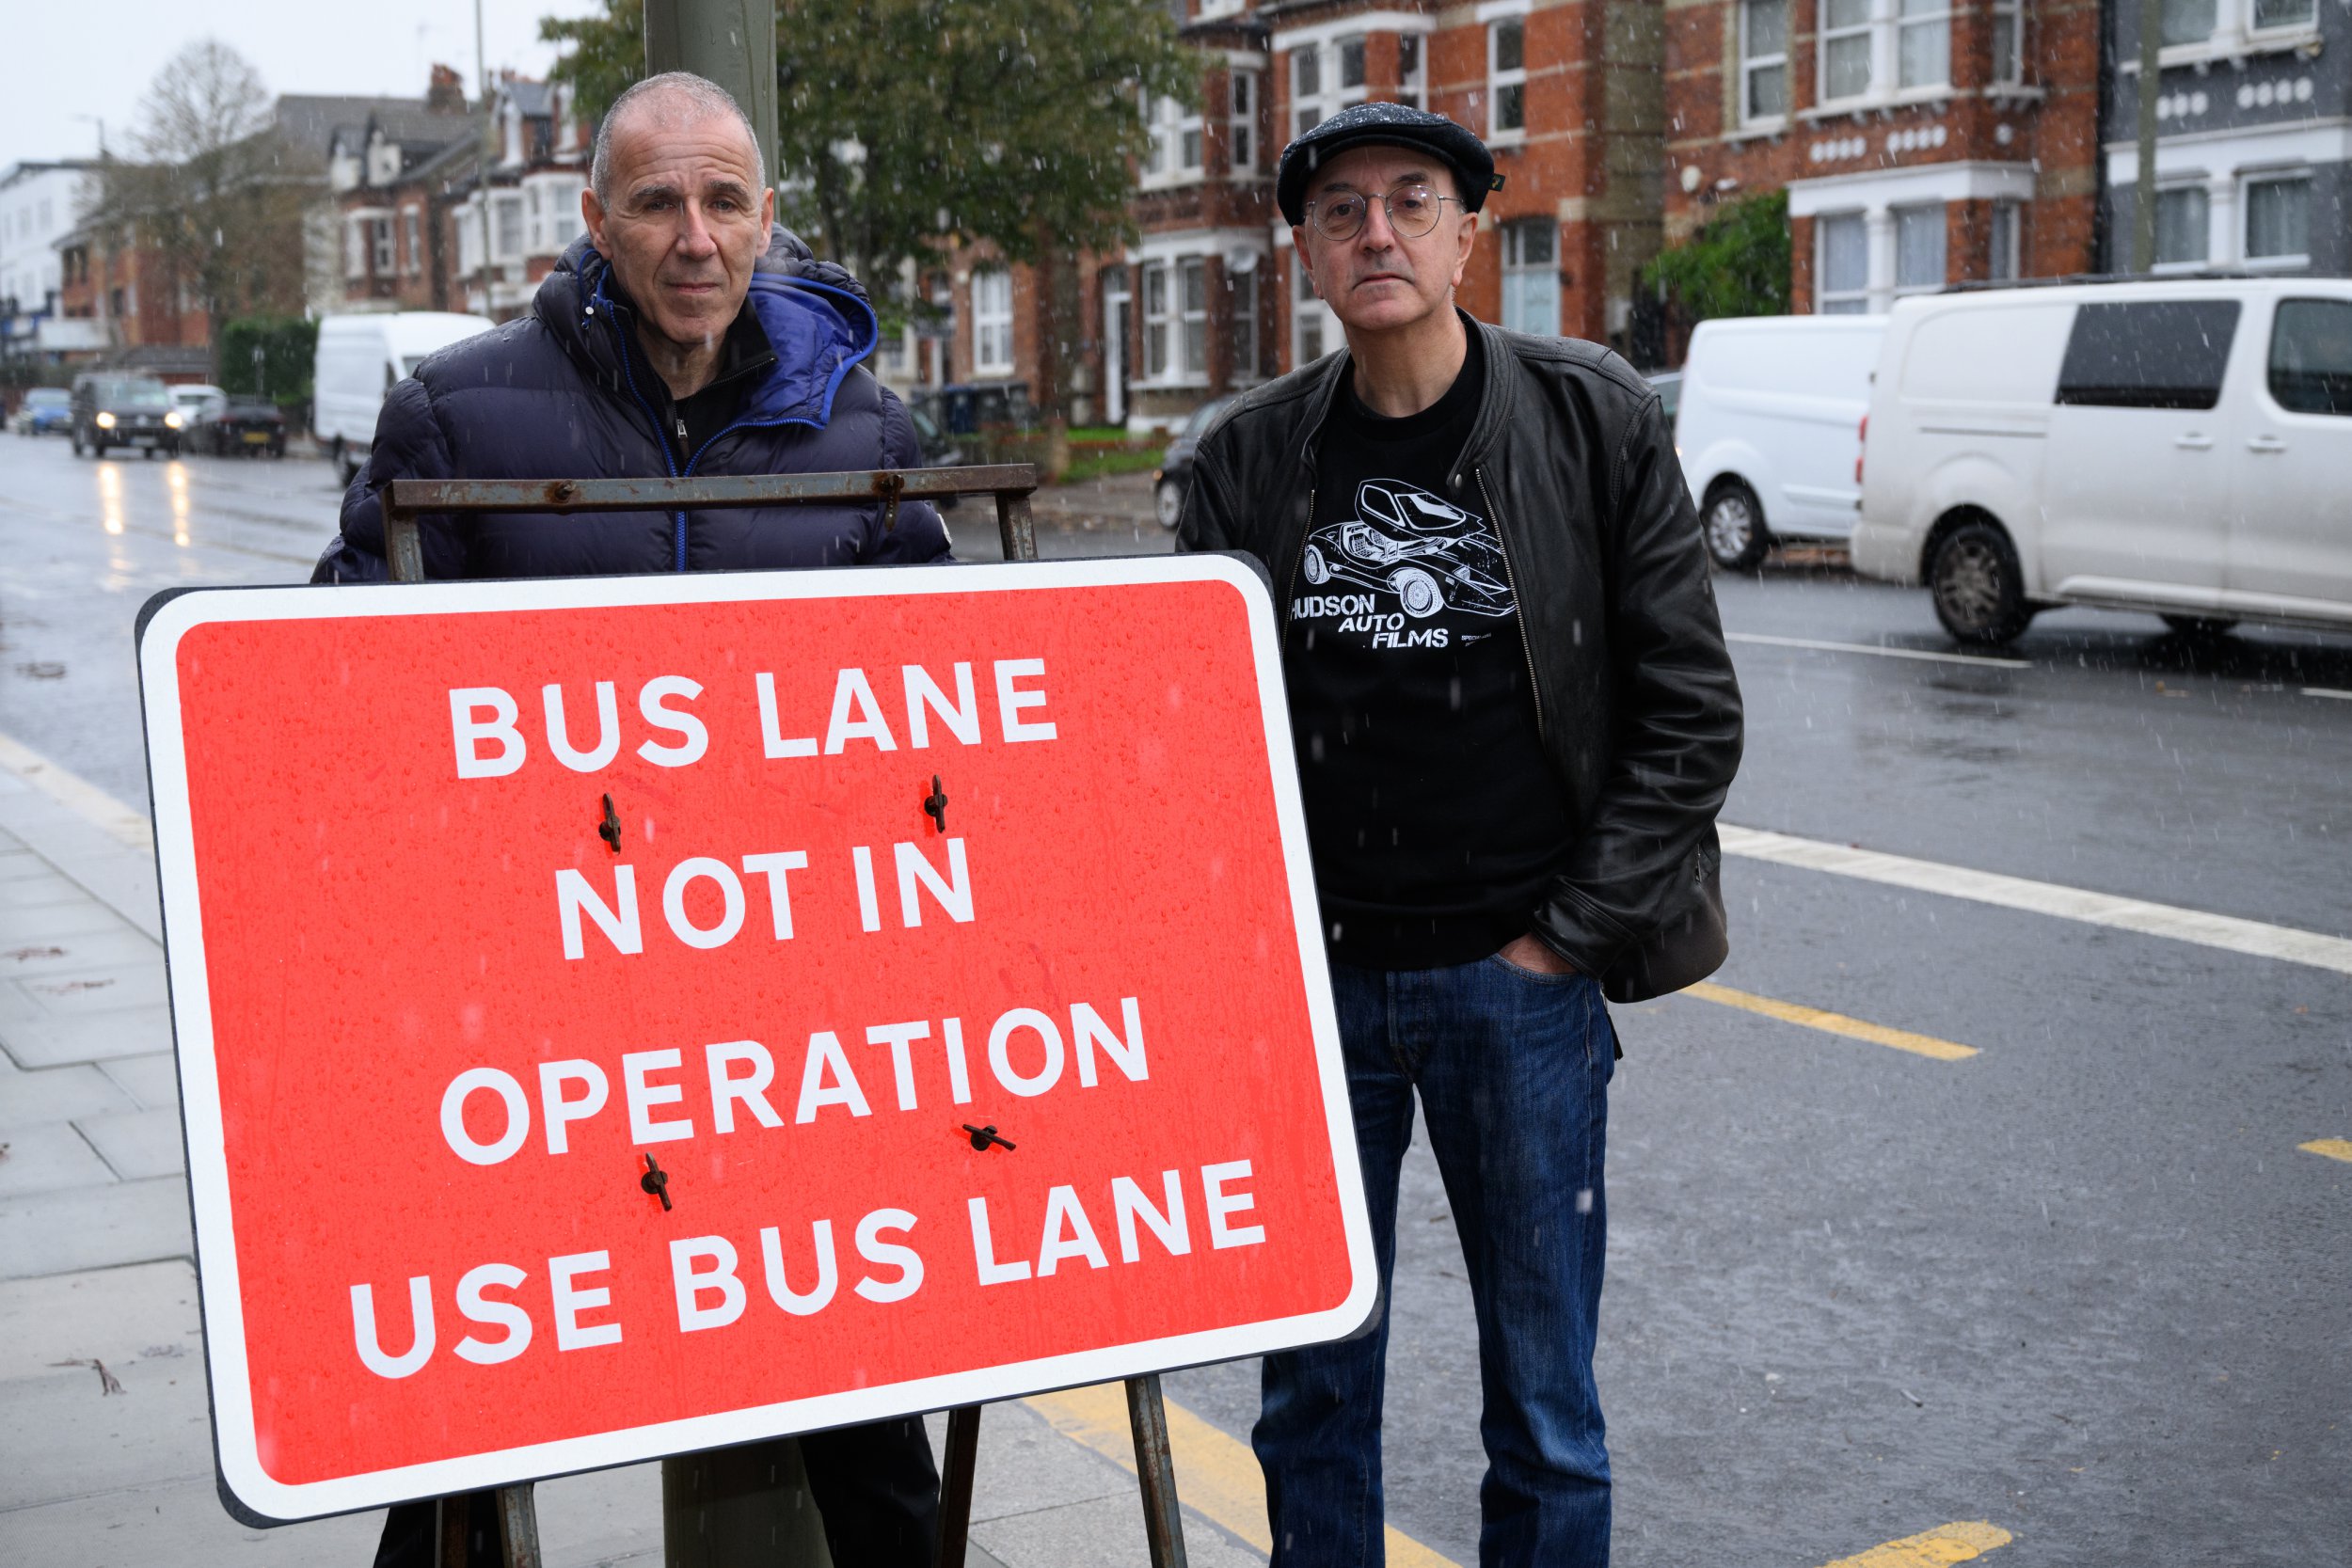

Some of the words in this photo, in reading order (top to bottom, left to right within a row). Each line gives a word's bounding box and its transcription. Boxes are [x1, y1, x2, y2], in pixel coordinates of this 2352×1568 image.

[1338, 612, 1405, 633] AUTO
[1372, 628, 1449, 649] FILMS
[448, 674, 709, 780] BUS
[755, 657, 1058, 759] LANE
[554, 849, 809, 960] NOT
[851, 837, 976, 933] IN
[439, 996, 1150, 1166] OPERATION
[349, 1249, 623, 1380] USE
[669, 1208, 925, 1333] BUS
[967, 1159, 1266, 1287] LANE
